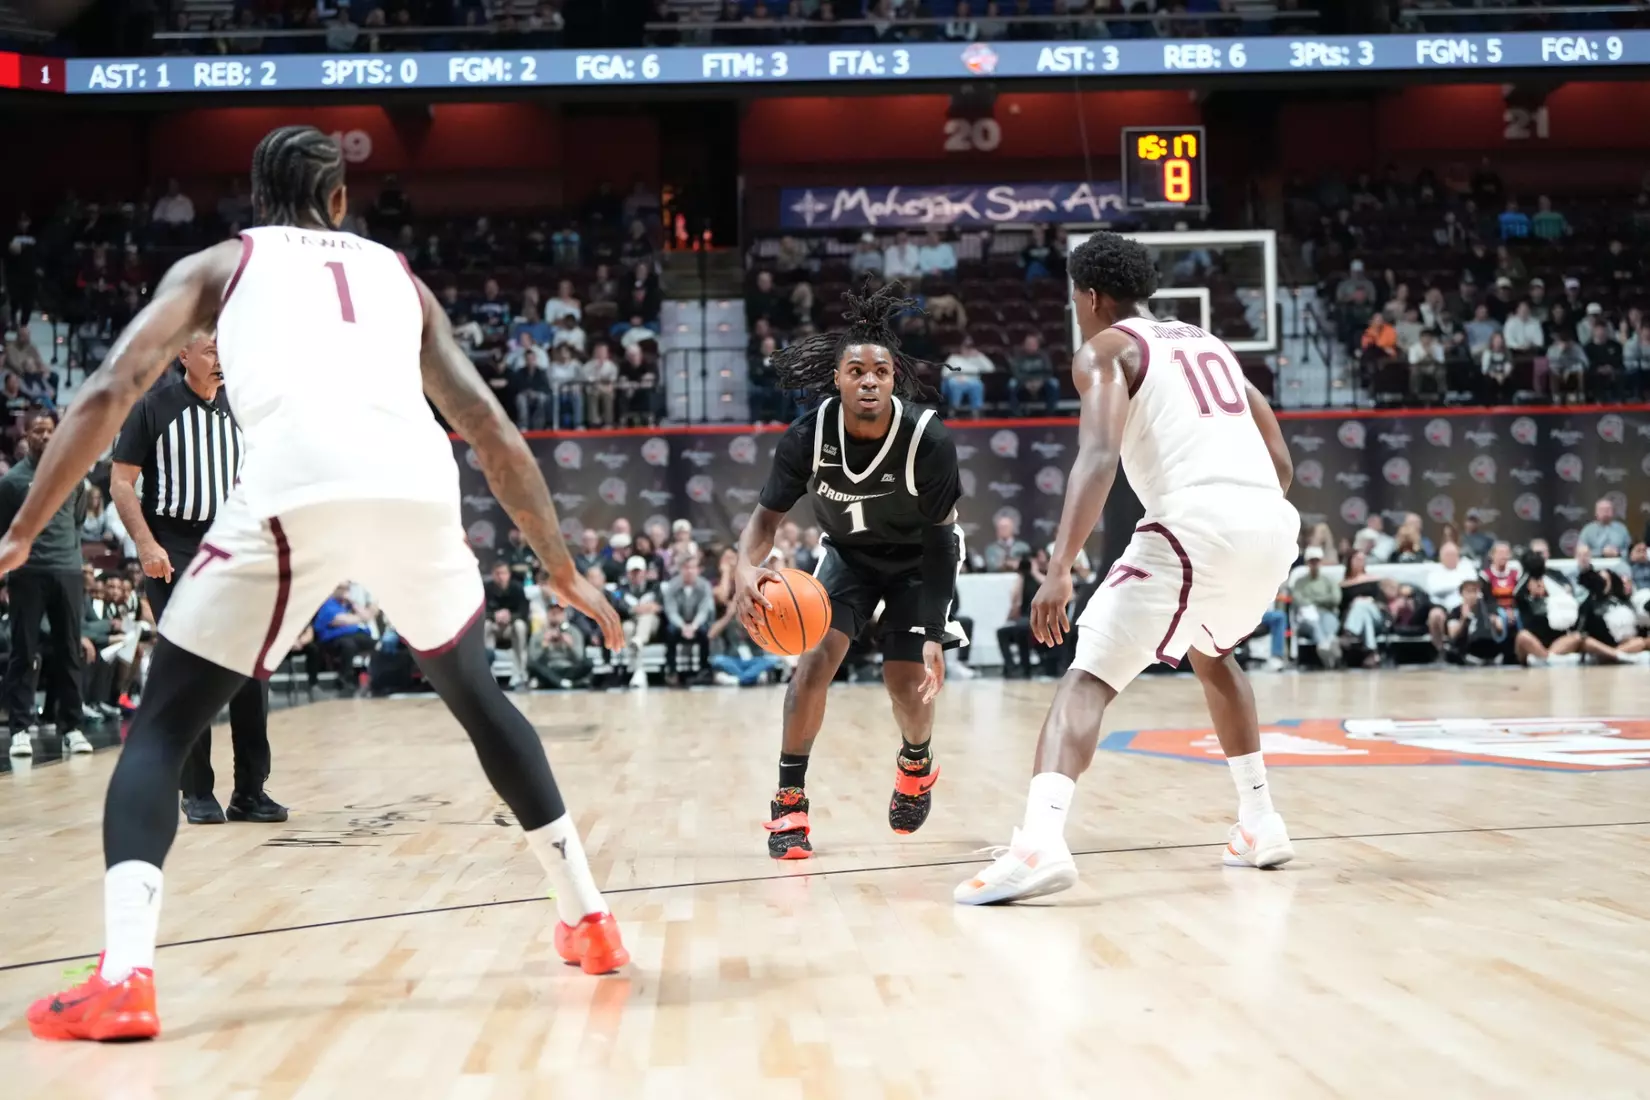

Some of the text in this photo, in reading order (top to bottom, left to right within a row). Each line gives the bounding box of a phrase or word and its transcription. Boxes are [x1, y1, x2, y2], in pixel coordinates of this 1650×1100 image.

[1037, 45, 1119, 72] AST: 3
[1163, 43, 1247, 69] REB: 6
[1289, 41, 1375, 67] 3Pts: 3
[1416, 38, 1503, 64] FGM: 5
[1542, 36, 1623, 61] FGA: 9
[40, 65, 50, 84] 1
[194, 61, 277, 87] REB: 2
[321, 58, 418, 85] 3PTS: 0
[449, 56, 538, 82] FGM: 2
[575, 54, 660, 80] FGA: 6
[702, 51, 789, 77] FTM: 3
[828, 49, 910, 75] FTA: 3
[89, 64, 170, 88] AST: 1
[942, 117, 1002, 152] 20
[1503, 107, 1550, 139] 21
[1137, 133, 1198, 161] 15:17
[1163, 158, 1192, 203] 8
[831, 186, 981, 225] Mohegan
[985, 186, 1057, 221] Sun
[323, 260, 357, 325] 1
[1171, 347, 1247, 418] 10
[841, 501, 869, 535] 1
